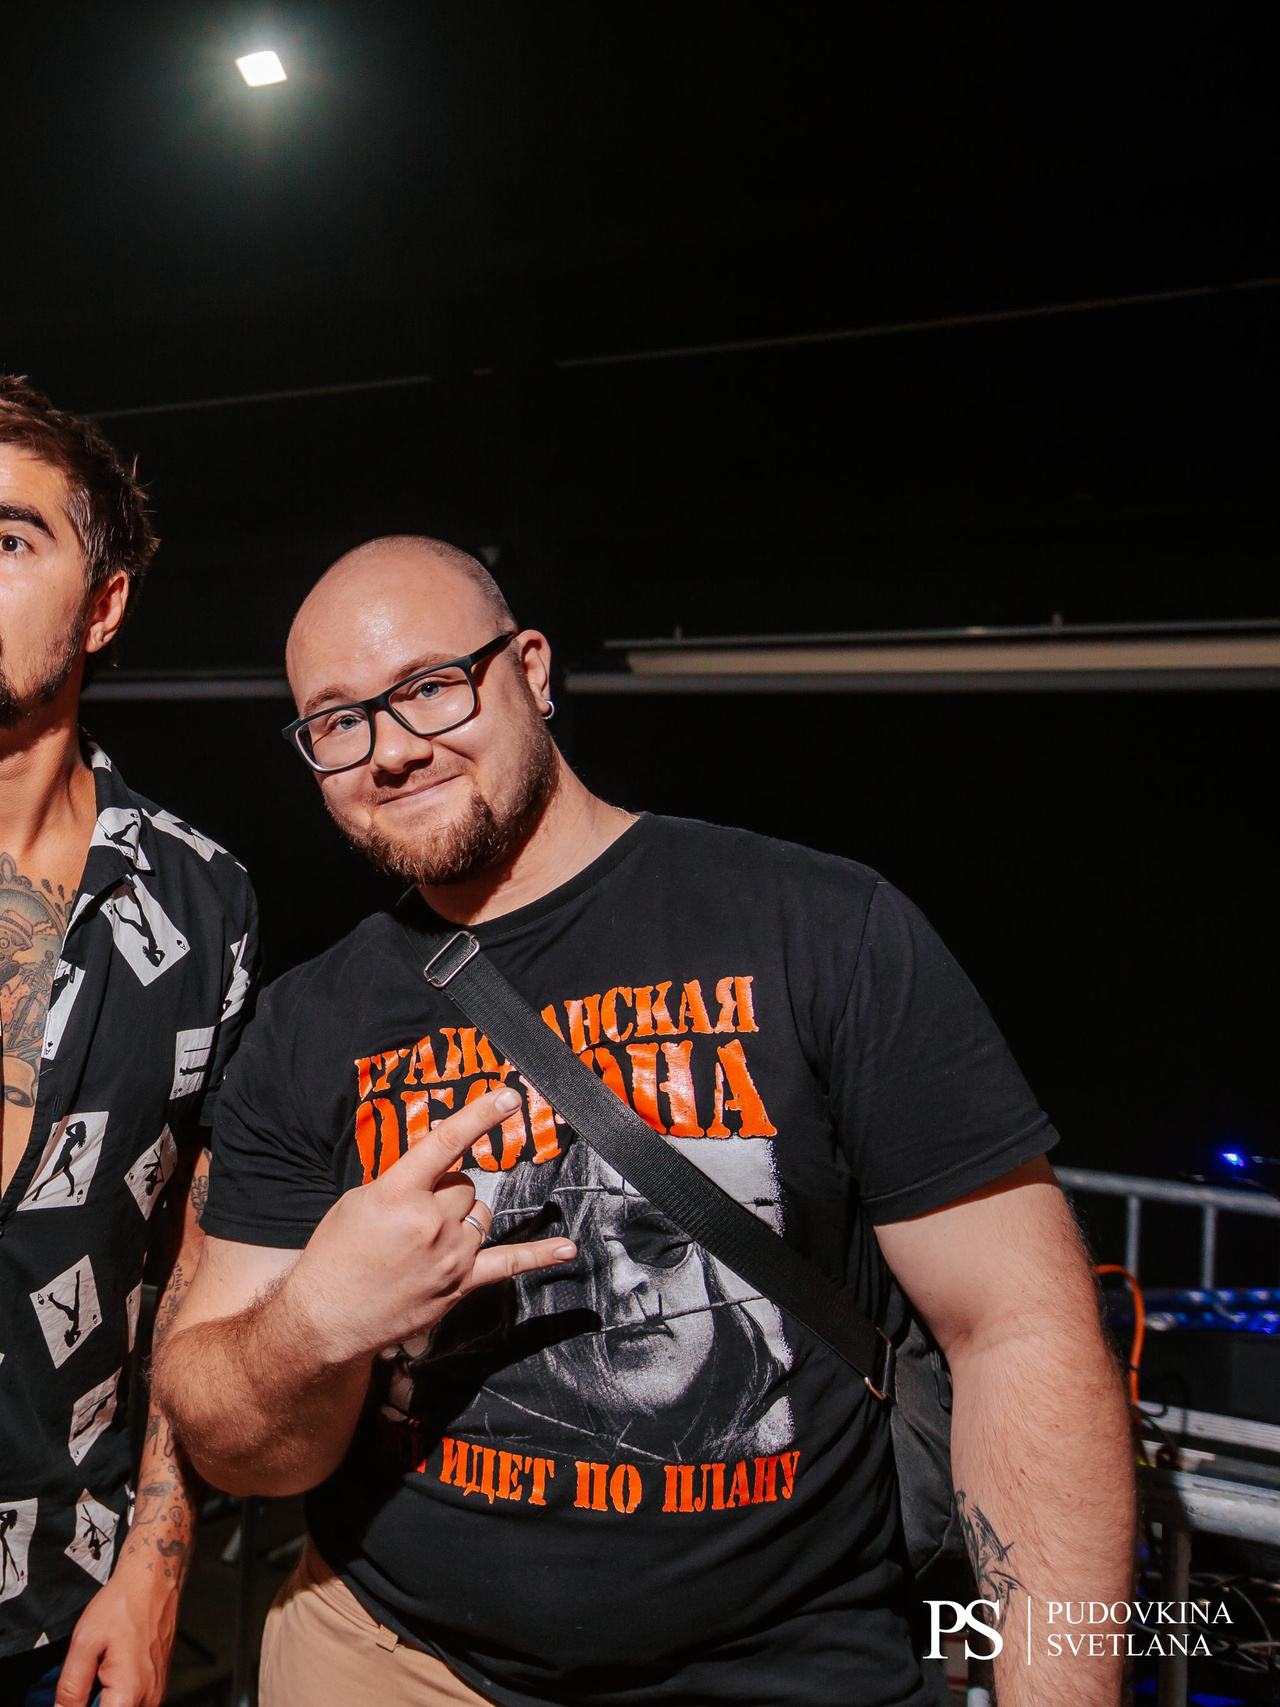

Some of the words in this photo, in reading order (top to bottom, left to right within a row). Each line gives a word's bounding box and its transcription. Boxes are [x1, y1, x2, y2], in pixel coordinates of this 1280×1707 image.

[354, 975, 759, 1102] ГРАЖНСКАЯ
[439, 1437, 555, 1505] ИДЕТ
[573, 1460, 643, 1514] ПО
[662, 1450, 801, 1513] ПЛАНУ
